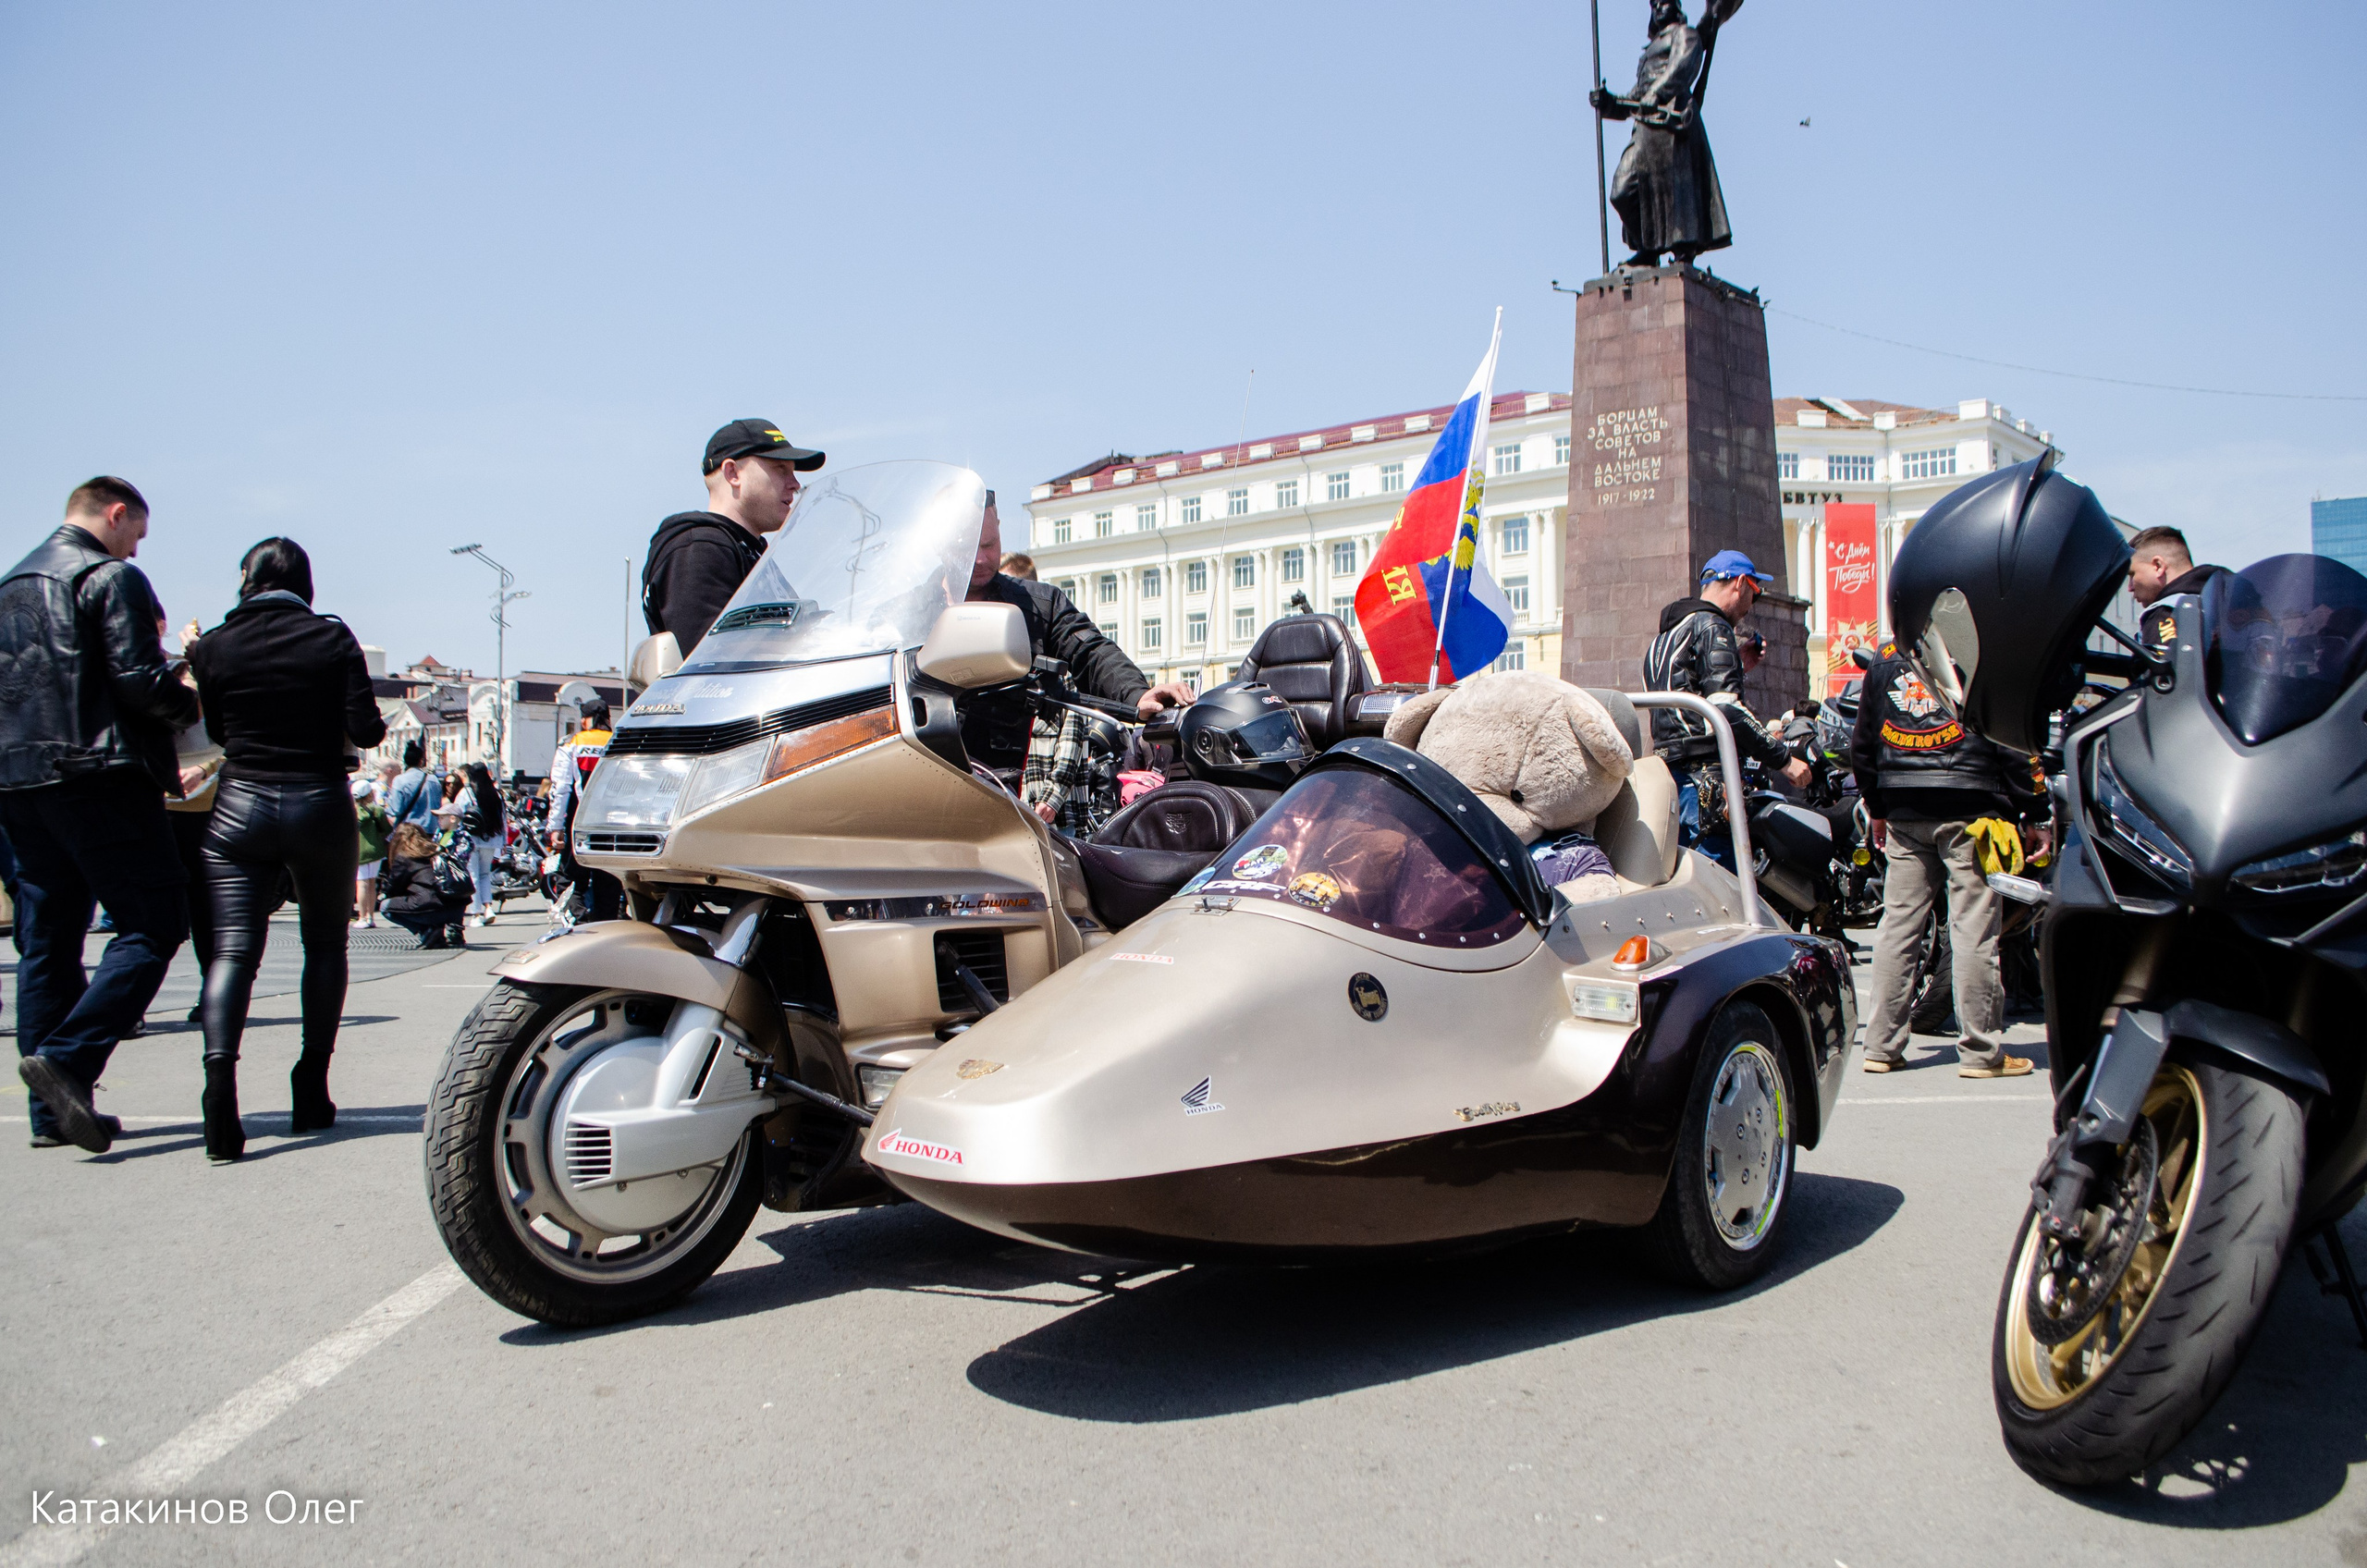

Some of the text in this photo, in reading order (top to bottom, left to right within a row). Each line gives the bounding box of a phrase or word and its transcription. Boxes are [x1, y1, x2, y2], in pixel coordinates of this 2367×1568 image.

[1597, 406, 1658, 426] БОРЦАМ
[1587, 417, 1668, 440] ЗА ВЛАСТЬ
[1595, 430, 1662, 451] СОВЕТОВ
[1618, 446, 1637, 459] НА
[1594, 456, 1662, 476] ДАЛЬНЕМ
[1594, 468, 1661, 488] ВОСТОКЕ
[1834, 542, 1870, 565] С Днём
[1828, 561, 1875, 594] Победы!
[1186, 1104, 1222, 1115] HONDA
[894, 1140, 963, 1165] HONDA
